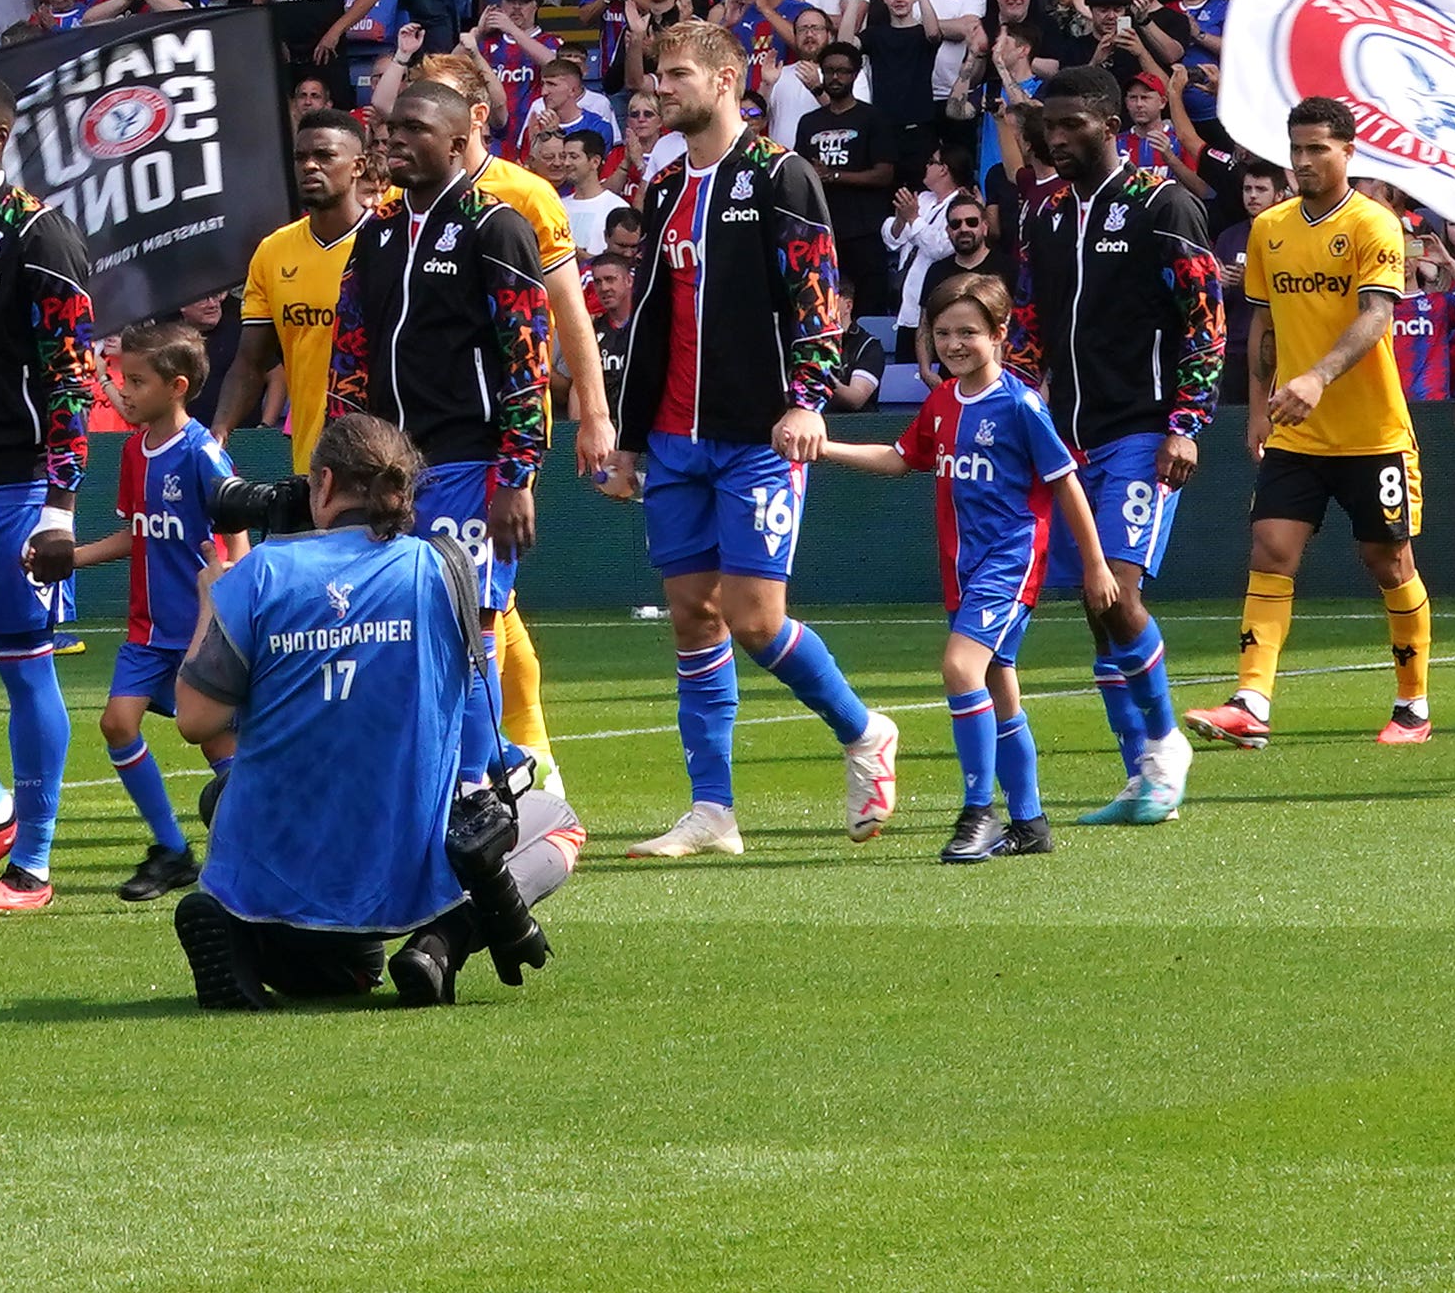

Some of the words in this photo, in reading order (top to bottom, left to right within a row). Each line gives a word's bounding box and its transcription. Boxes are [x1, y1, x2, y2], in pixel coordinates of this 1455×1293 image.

[748, 52, 766, 65] W8
[721, 206, 759, 223] cinch
[1095, 238, 1128, 254] cinch
[1273, 241, 1352, 268] AstroPay
[423, 256, 457, 274] cinch
[282, 302, 334, 327] Astro
[1393, 316, 1433, 335] nch
[1122, 480, 1153, 525] 8
[1379, 469, 1403, 507] 8
[752, 487, 793, 534] 16
[131, 510, 184, 541] nch
[430, 516, 490, 567] 28
[270, 619, 412, 654] PHOTOGRAPHER
[321, 659, 357, 701] 17
